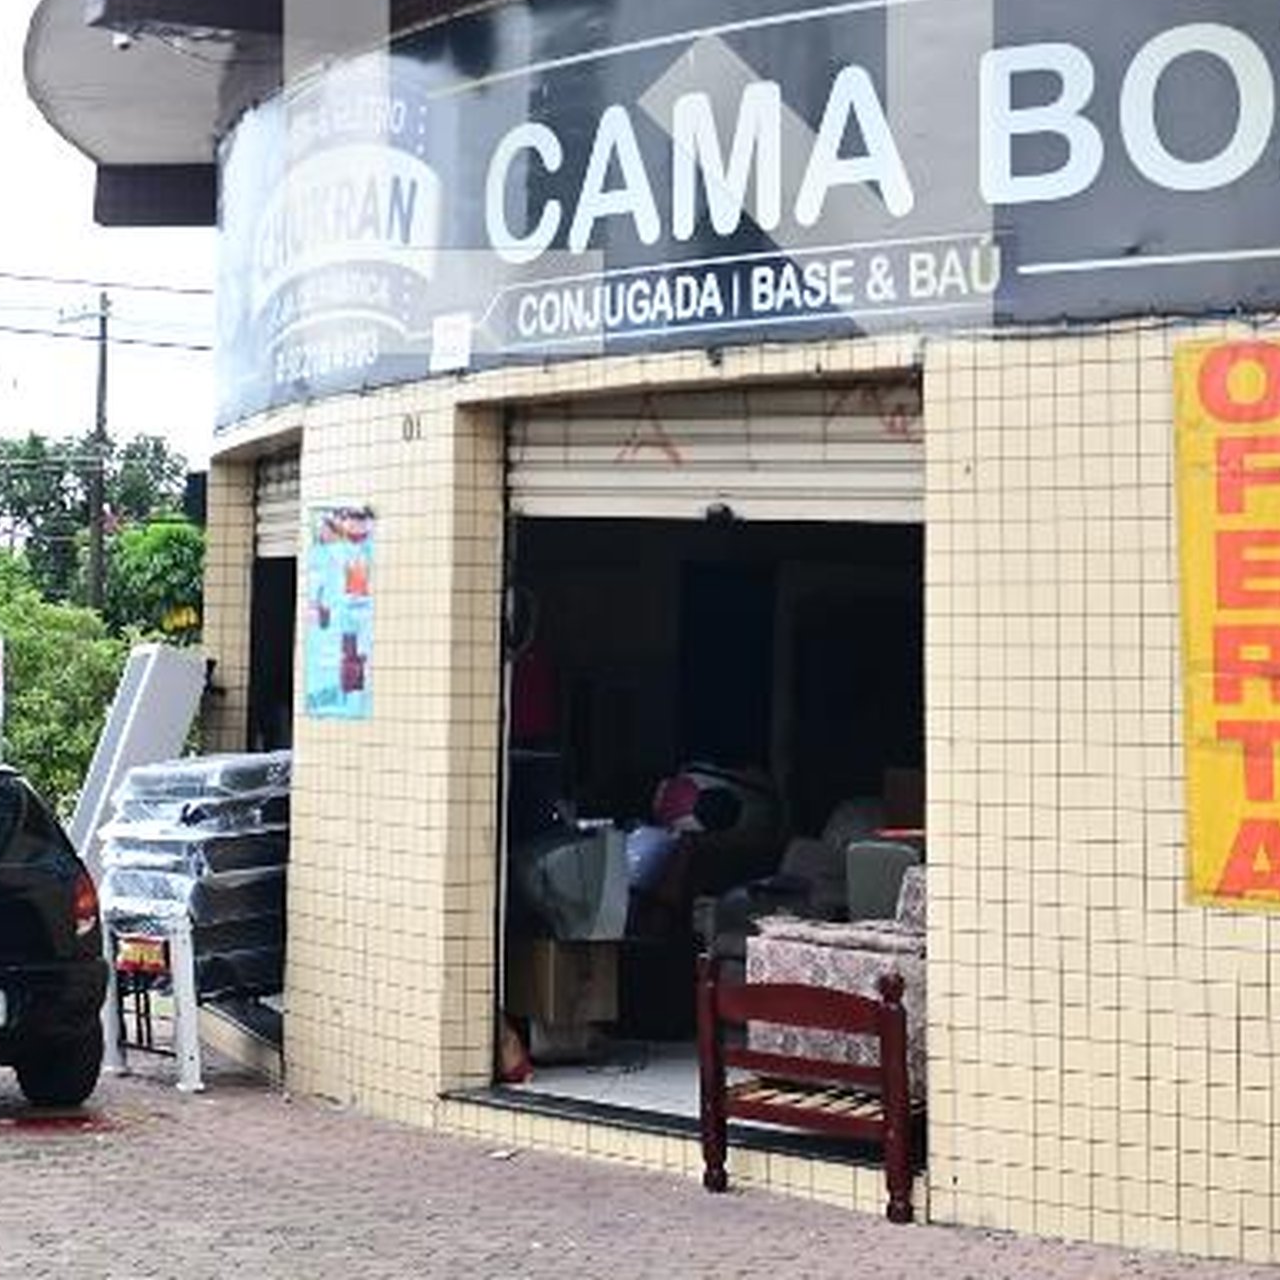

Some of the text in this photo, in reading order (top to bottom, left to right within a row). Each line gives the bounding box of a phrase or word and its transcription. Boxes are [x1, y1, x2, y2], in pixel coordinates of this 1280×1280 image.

[486, 65, 914, 264] CAMA
[519, 274, 722, 337] CONJUGADA
[751, 259, 854, 312] BASE
[866, 255, 897, 301] &
[909, 232, 1001, 299] BAÚ
